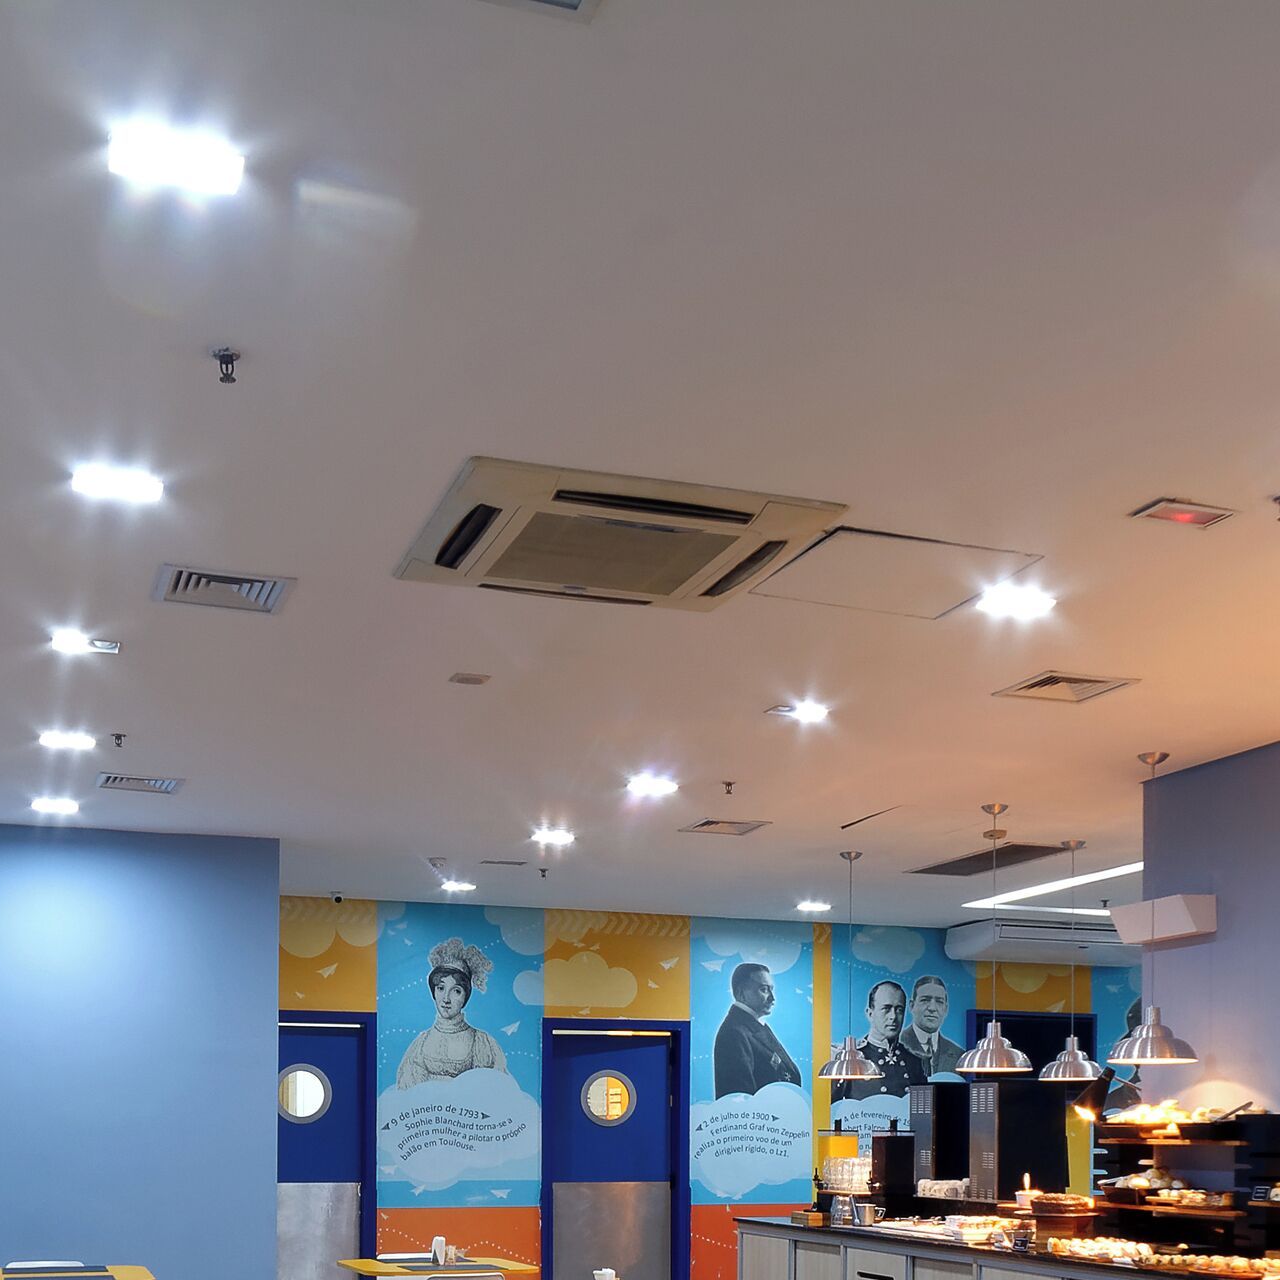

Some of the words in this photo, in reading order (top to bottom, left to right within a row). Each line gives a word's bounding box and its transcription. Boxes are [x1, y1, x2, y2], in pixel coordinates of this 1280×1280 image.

[399, 1111, 410, 1121] de
[412, 1104, 443, 1118] janeiro
[446, 1104, 457, 1113] de
[459, 1108, 479, 1119] 1793
[721, 1112, 739, 1122] julho
[752, 1112, 770, 1120] 1900
[861, 1110, 891, 1120] fevereiro
[405, 1117, 433, 1131] Sophie
[435, 1116, 474, 1130] Blanchard
[476, 1121, 506, 1131] torna-se
[710, 1123, 748, 1136] Ferdinand
[749, 1123, 765, 1131] Graf
[767, 1126, 779, 1134] von
[781, 1128, 810, 1139] Zeppelin
[397, 1130, 430, 1150] primeira
[432, 1127, 461, 1138] mulher
[468, 1133, 493, 1142] pilotar
[502, 1123, 527, 1141] próprio
[400, 1144, 422, 1161] balão
[424, 1140, 437, 1148] em
[439, 1138, 476, 1151] Toulouse.
[694, 1140, 715, 1159] realiza
[723, 1134, 754, 1144] primeiro
